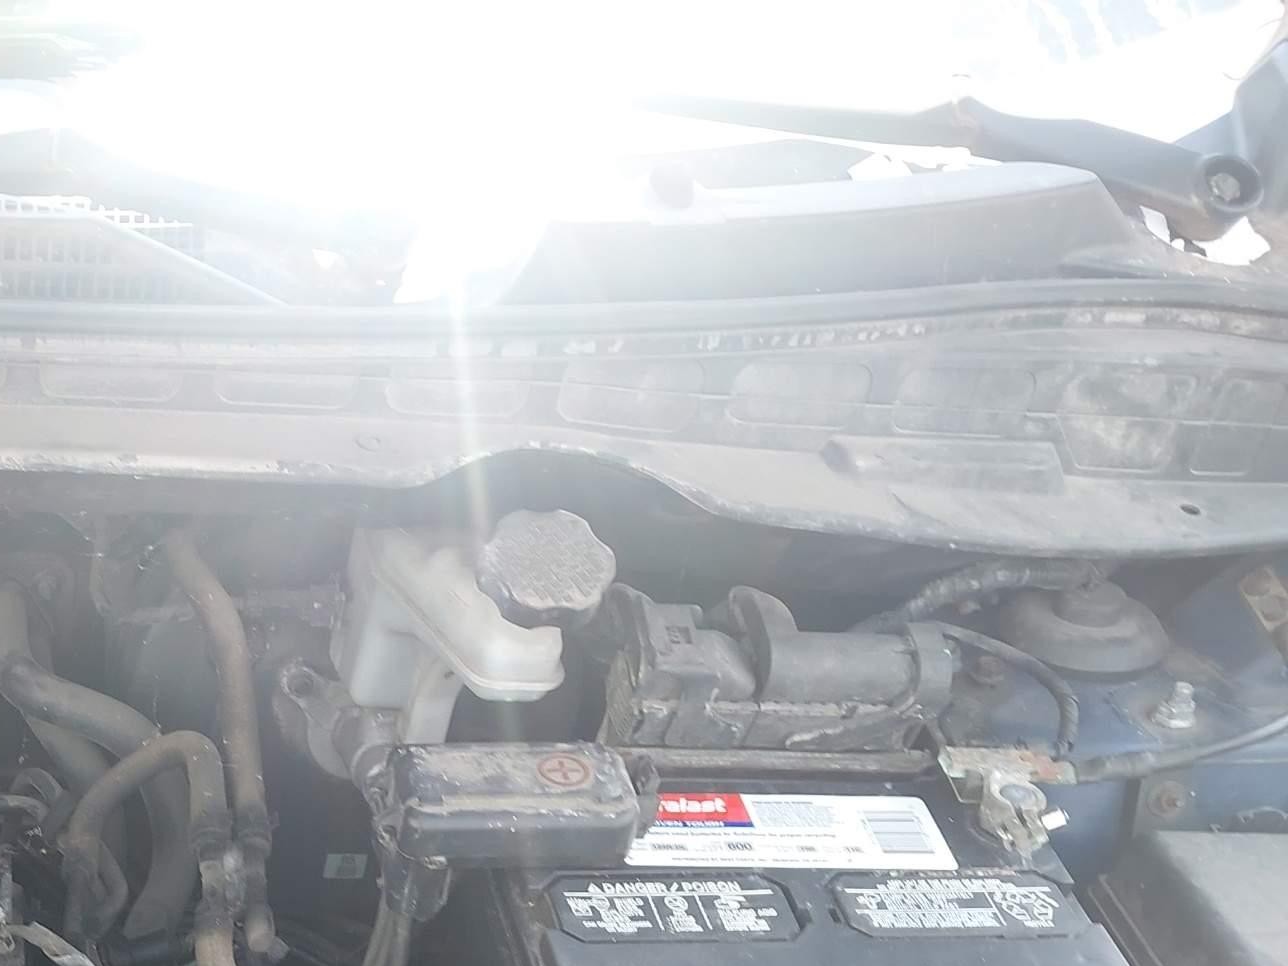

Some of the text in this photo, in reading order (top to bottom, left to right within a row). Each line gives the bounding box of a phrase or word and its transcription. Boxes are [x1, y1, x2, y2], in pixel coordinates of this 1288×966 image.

[659, 797, 728, 813] ralast
[602, 882, 668, 894] DANGER
[682, 881, 742, 893] POISON
